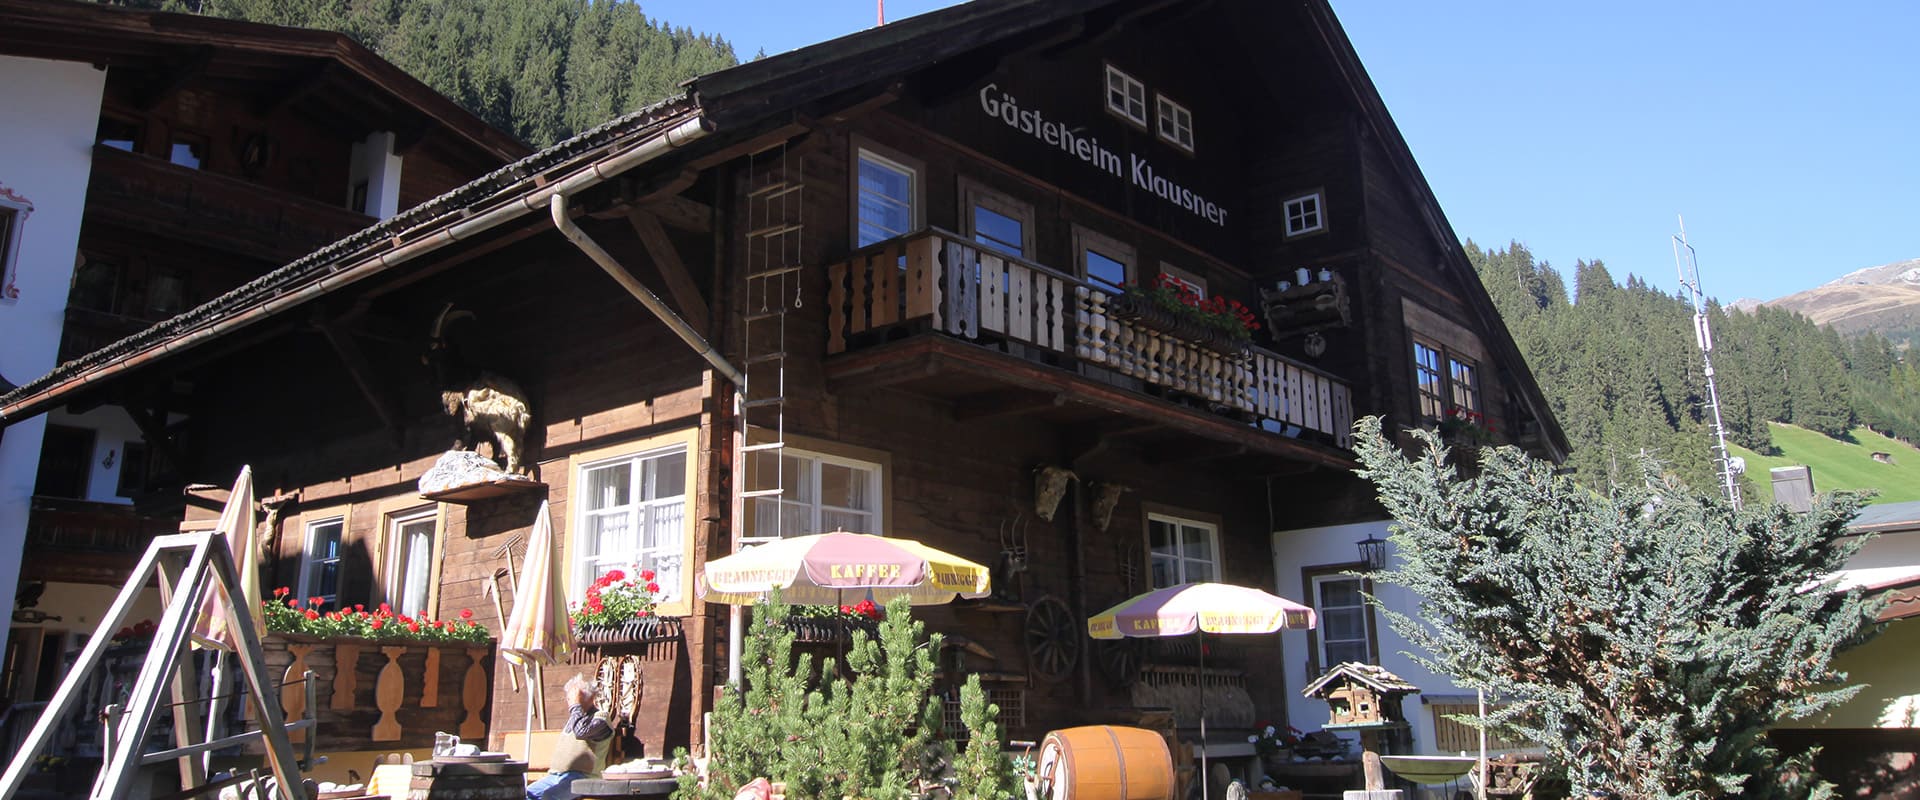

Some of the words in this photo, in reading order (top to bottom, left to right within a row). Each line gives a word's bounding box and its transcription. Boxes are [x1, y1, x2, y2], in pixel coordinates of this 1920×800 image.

[979, 83, 1122, 177] Gästeheim
[1130, 152, 1228, 227] Klausner
[830, 563, 902, 579] KAFFEE
